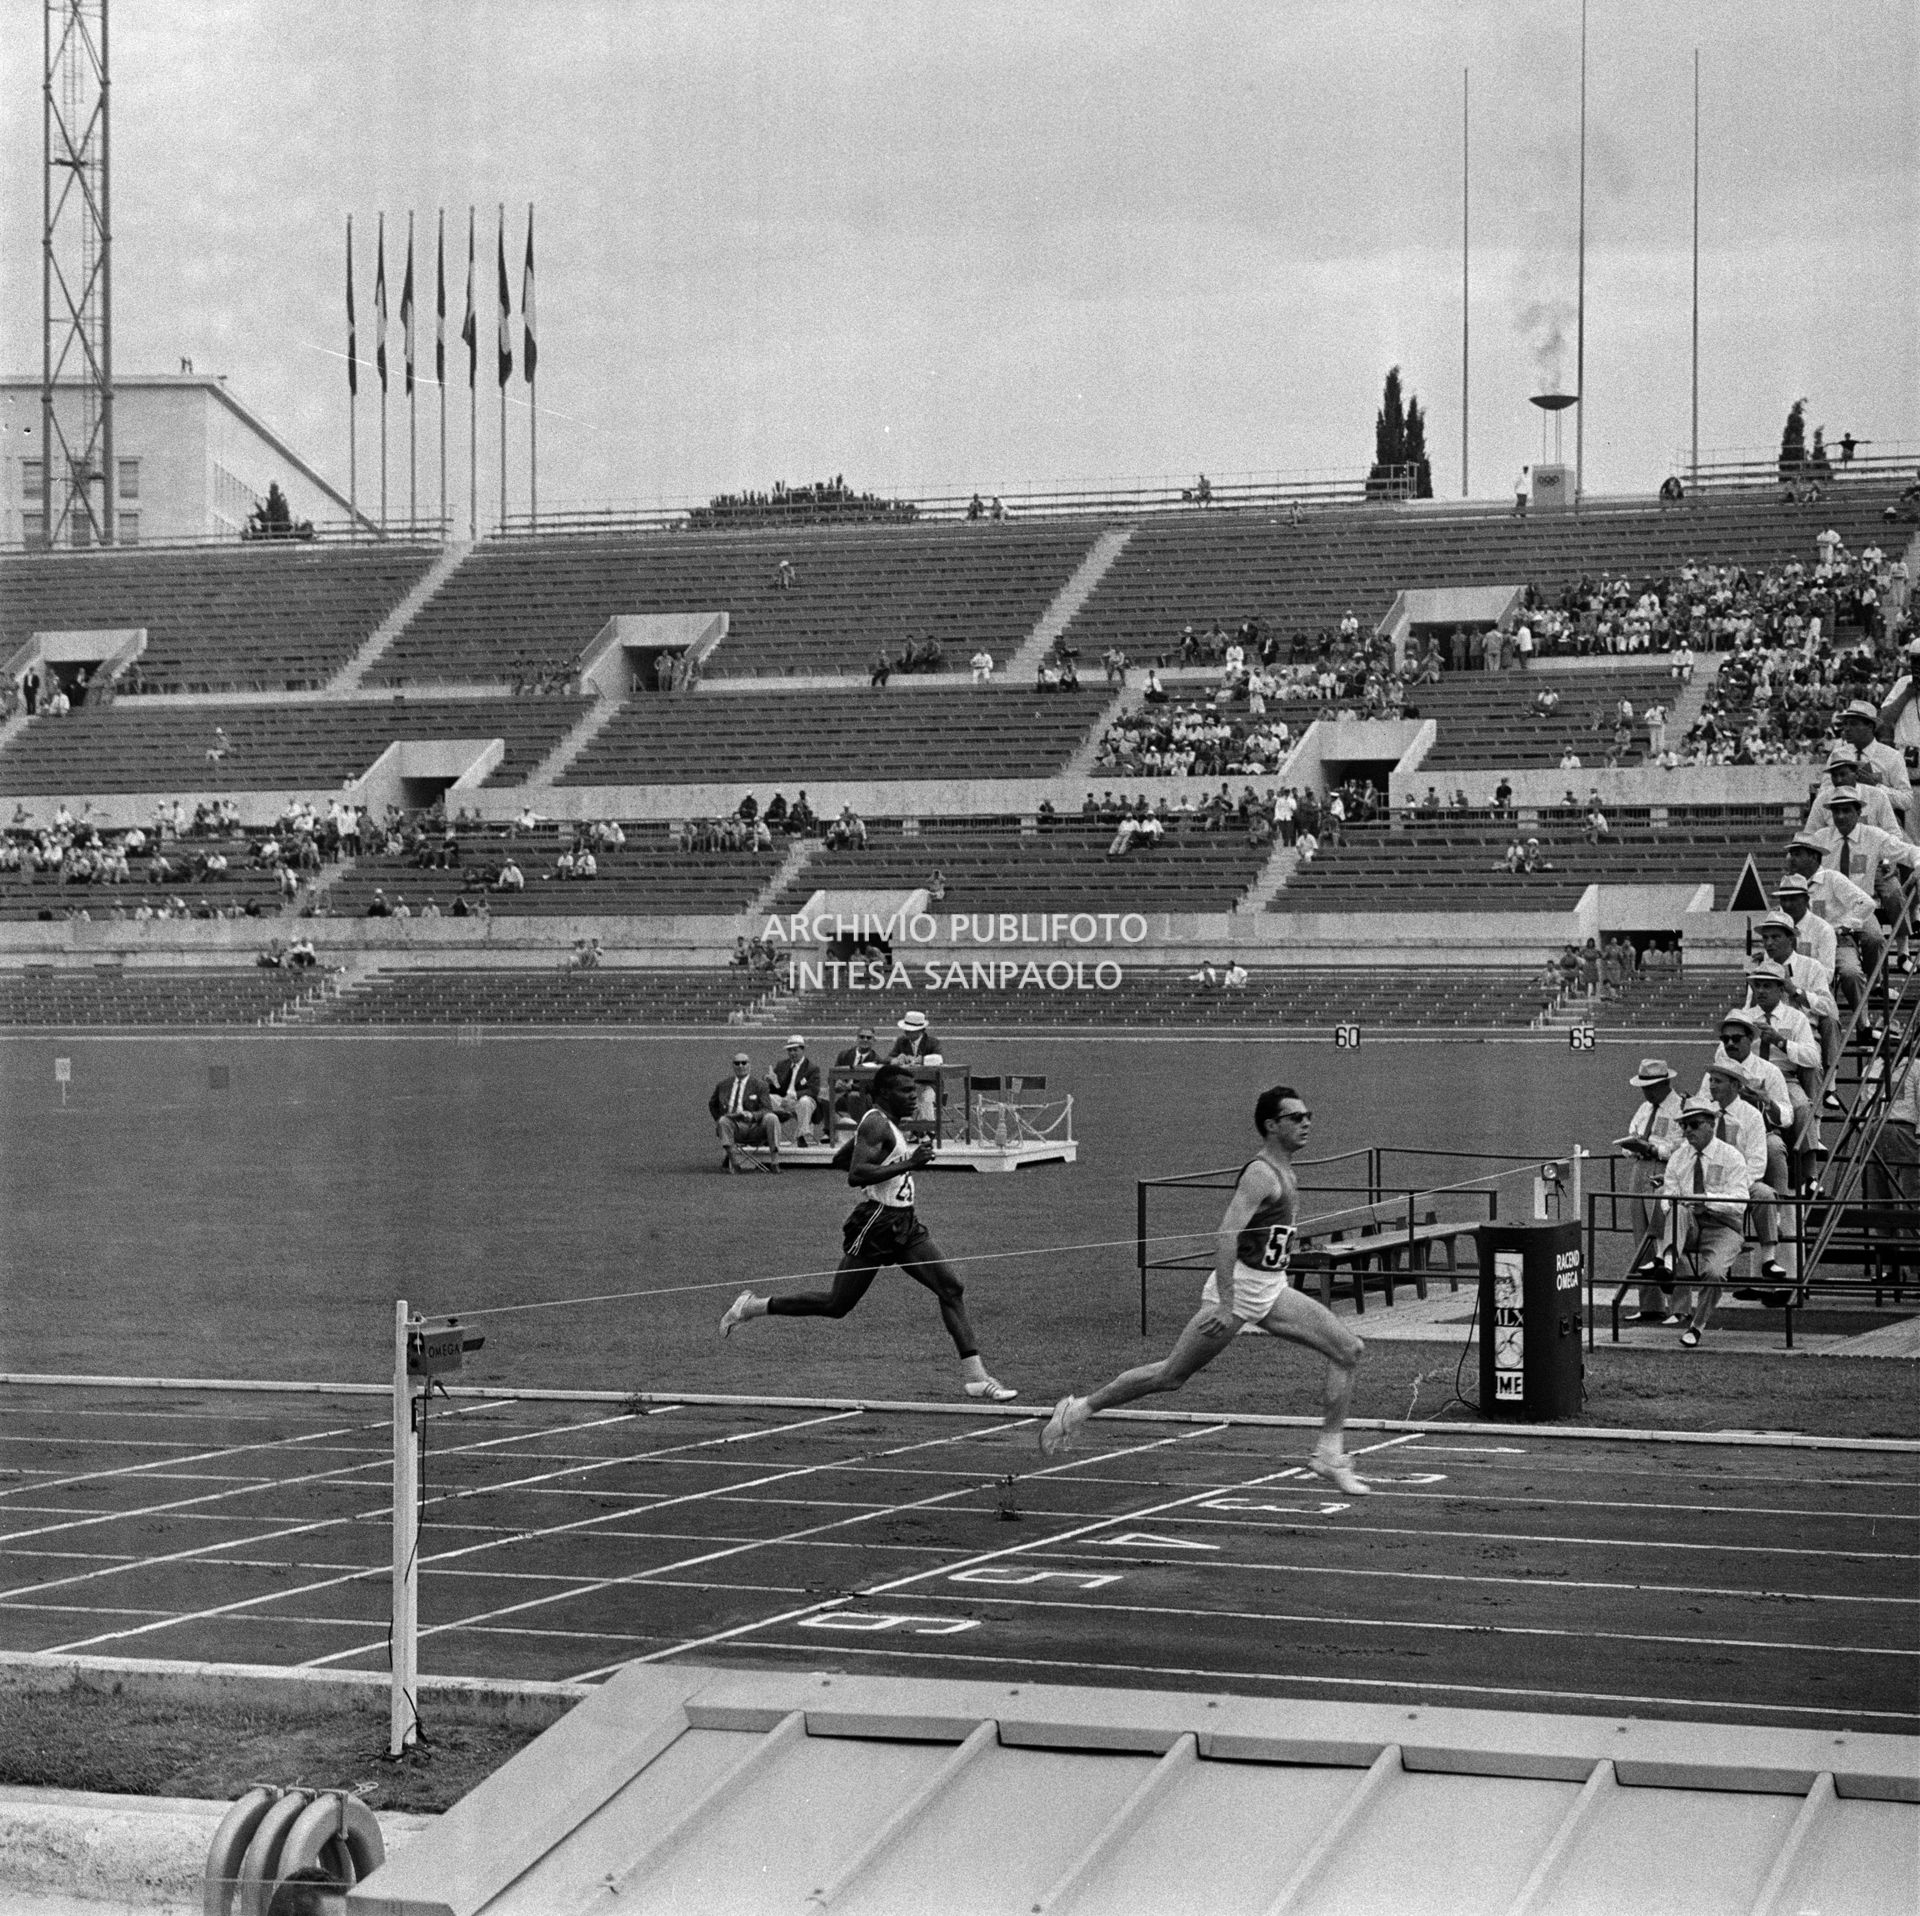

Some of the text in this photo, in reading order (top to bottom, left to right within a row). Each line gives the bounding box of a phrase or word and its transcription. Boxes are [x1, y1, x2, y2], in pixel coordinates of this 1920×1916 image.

[1335, 1026, 1360, 1048] 60
[1570, 1027, 1595, 1049] 65
[1557, 1250, 1580, 1271] RACEND
[1557, 1271, 1578, 1290] OMEGA
[428, 1343, 460, 1358] OMEGA
[1496, 1376, 1522, 1394] ME
[1077, 1533, 1220, 1549] 4
[948, 1568, 1123, 1588] 5
